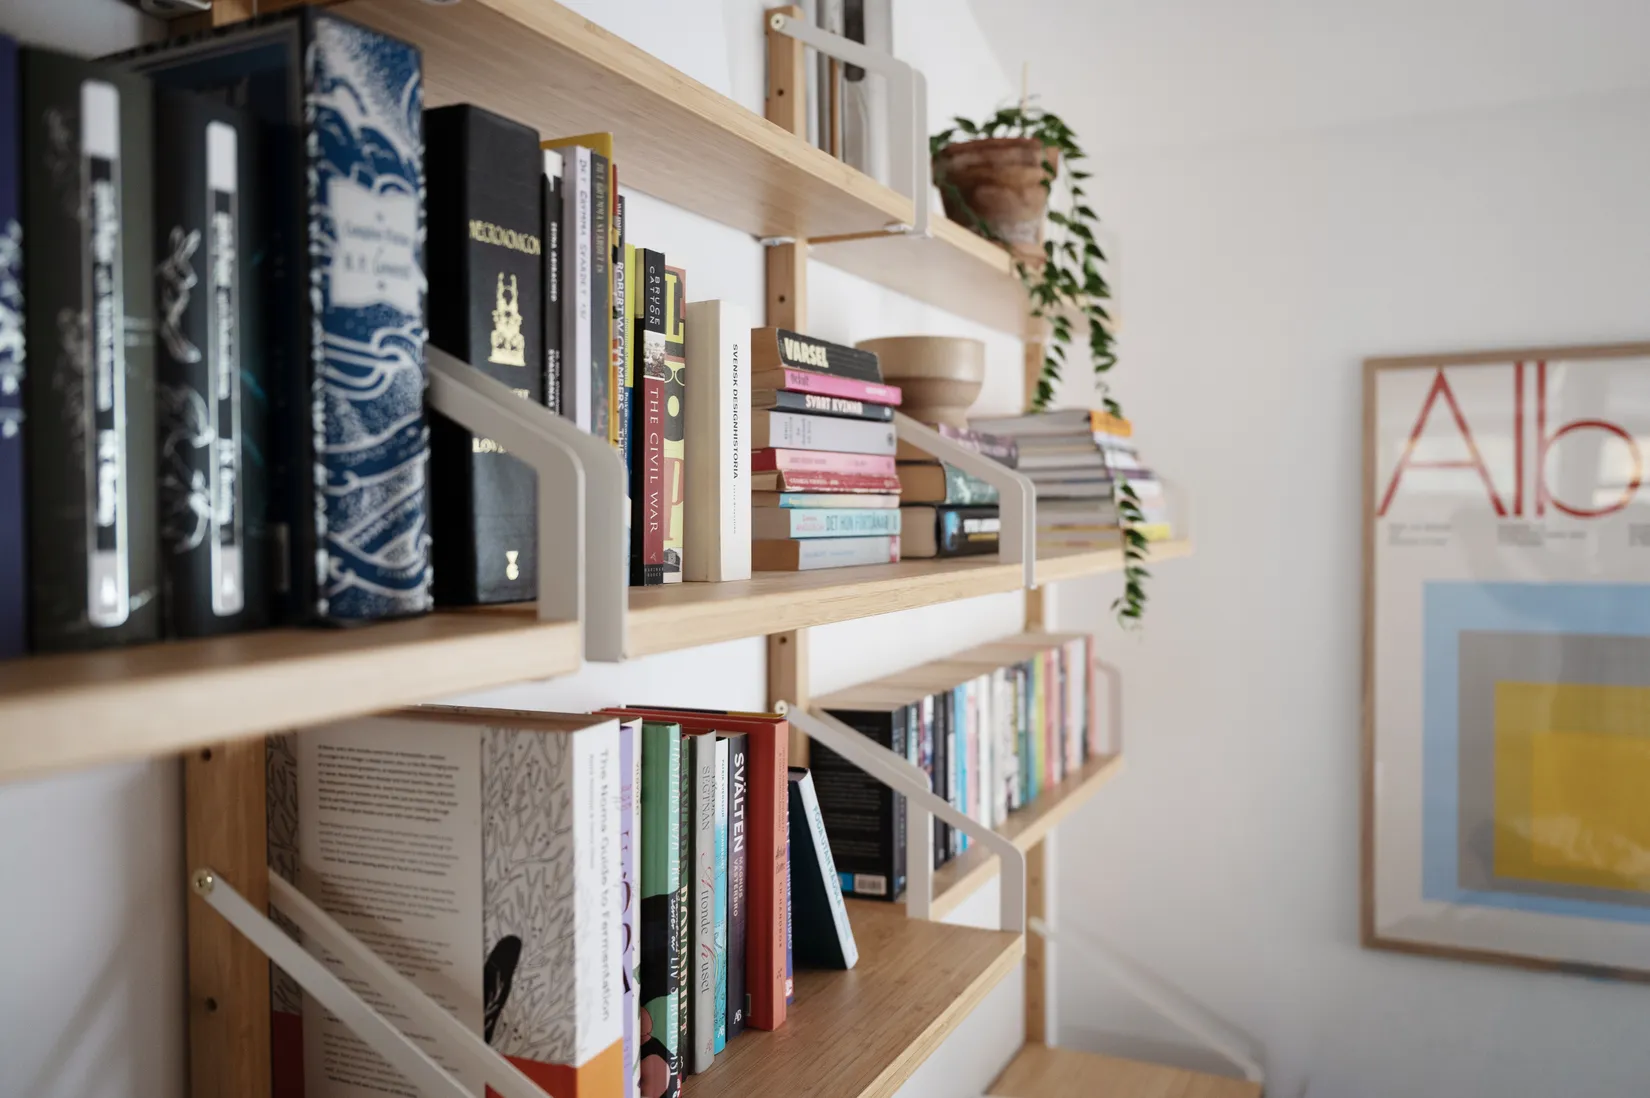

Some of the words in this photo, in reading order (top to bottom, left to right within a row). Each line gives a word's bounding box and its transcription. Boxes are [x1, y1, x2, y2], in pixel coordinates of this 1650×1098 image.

[469, 219, 541, 255] NECRONOMICON
[784, 337, 829, 368] VARSEL
[650, 388, 659, 424] THE
[650, 432, 659, 484] CIVIL
[650, 492, 659, 533] WAR
[599, 749, 609, 779] The
[599, 785, 609, 833] Noma
[702, 766, 710, 831] SEGTNAN
[734, 752, 746, 853] SVÄLTEN
[599, 839, 610, 886] Guide
[600, 889, 610, 908] to
[600, 911, 610, 1022] Fermentation
[670, 957, 679, 979] LIV
[700, 943, 715, 994] huset
